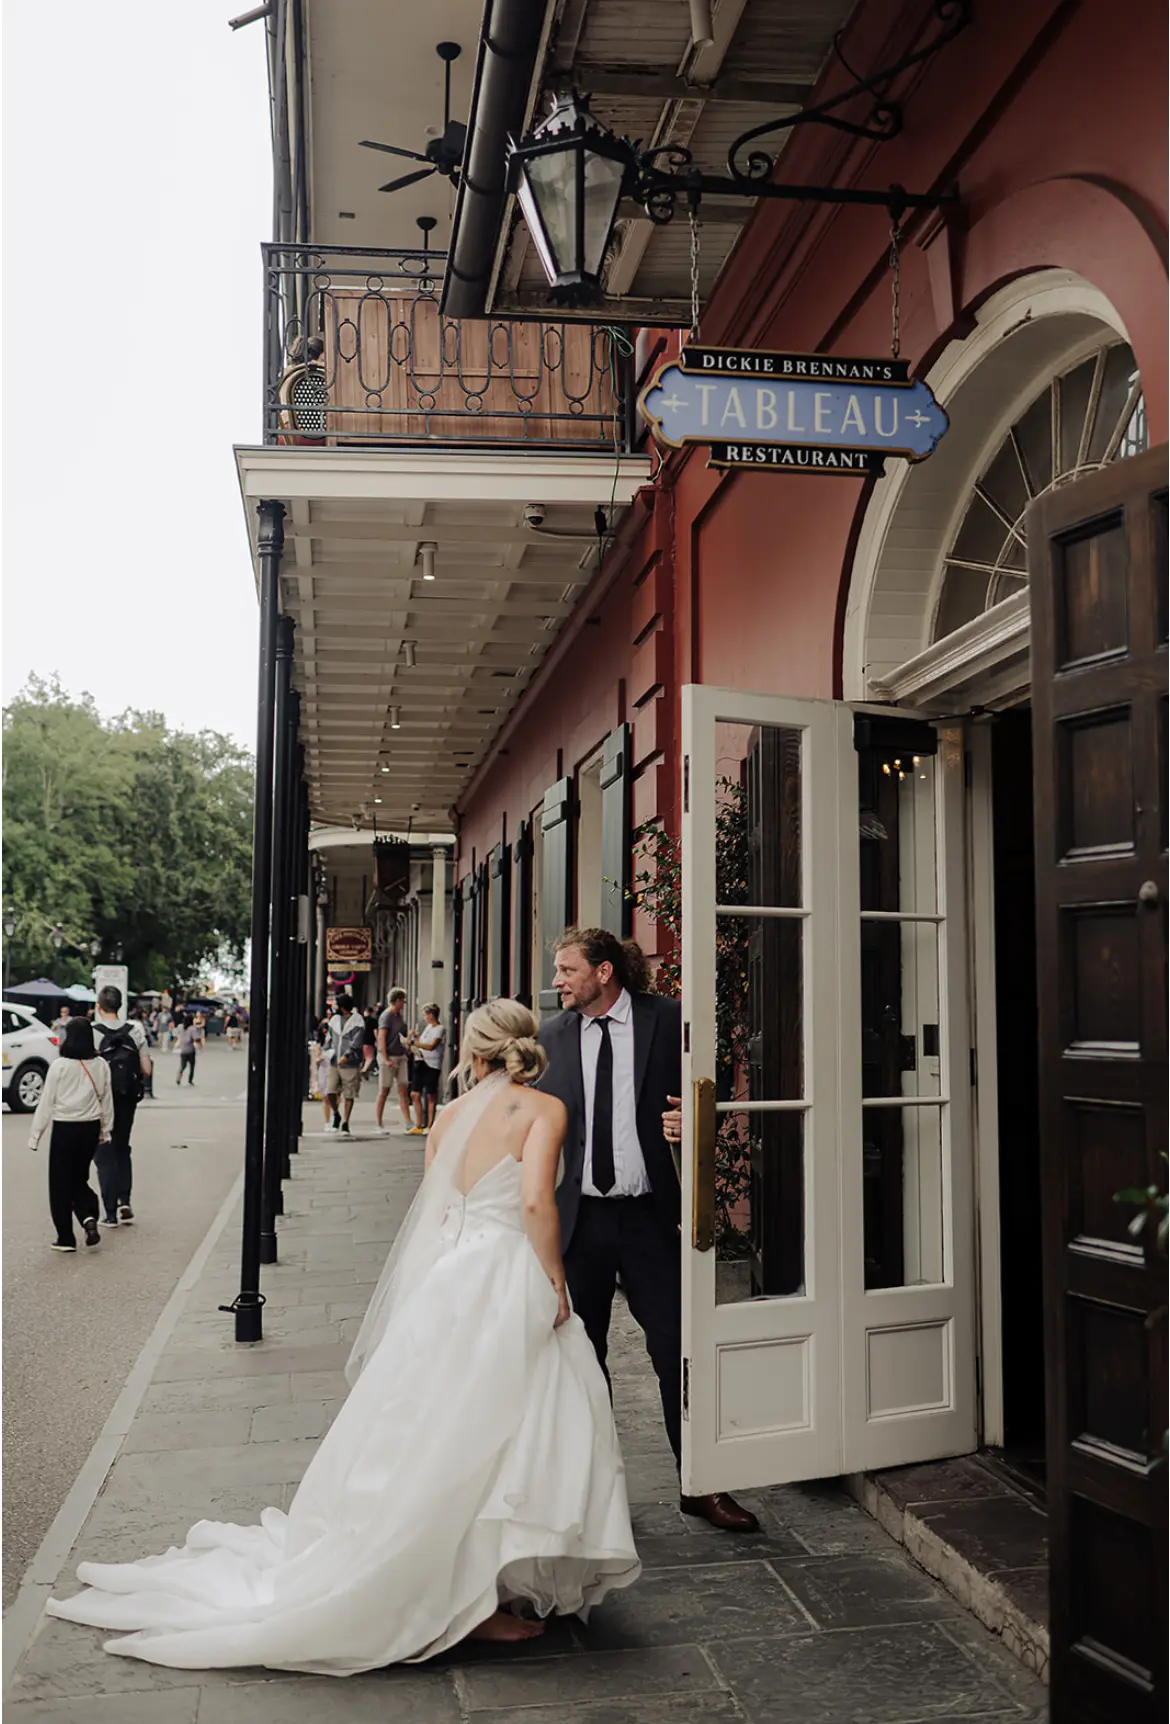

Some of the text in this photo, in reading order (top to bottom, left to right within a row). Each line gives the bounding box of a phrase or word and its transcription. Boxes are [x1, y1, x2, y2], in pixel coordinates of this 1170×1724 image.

[702, 354, 892, 380] DICKIE BRENNAN'S
[695, 384, 898, 437] TABLEAU
[726, 445, 868, 468] RESTAURANT
